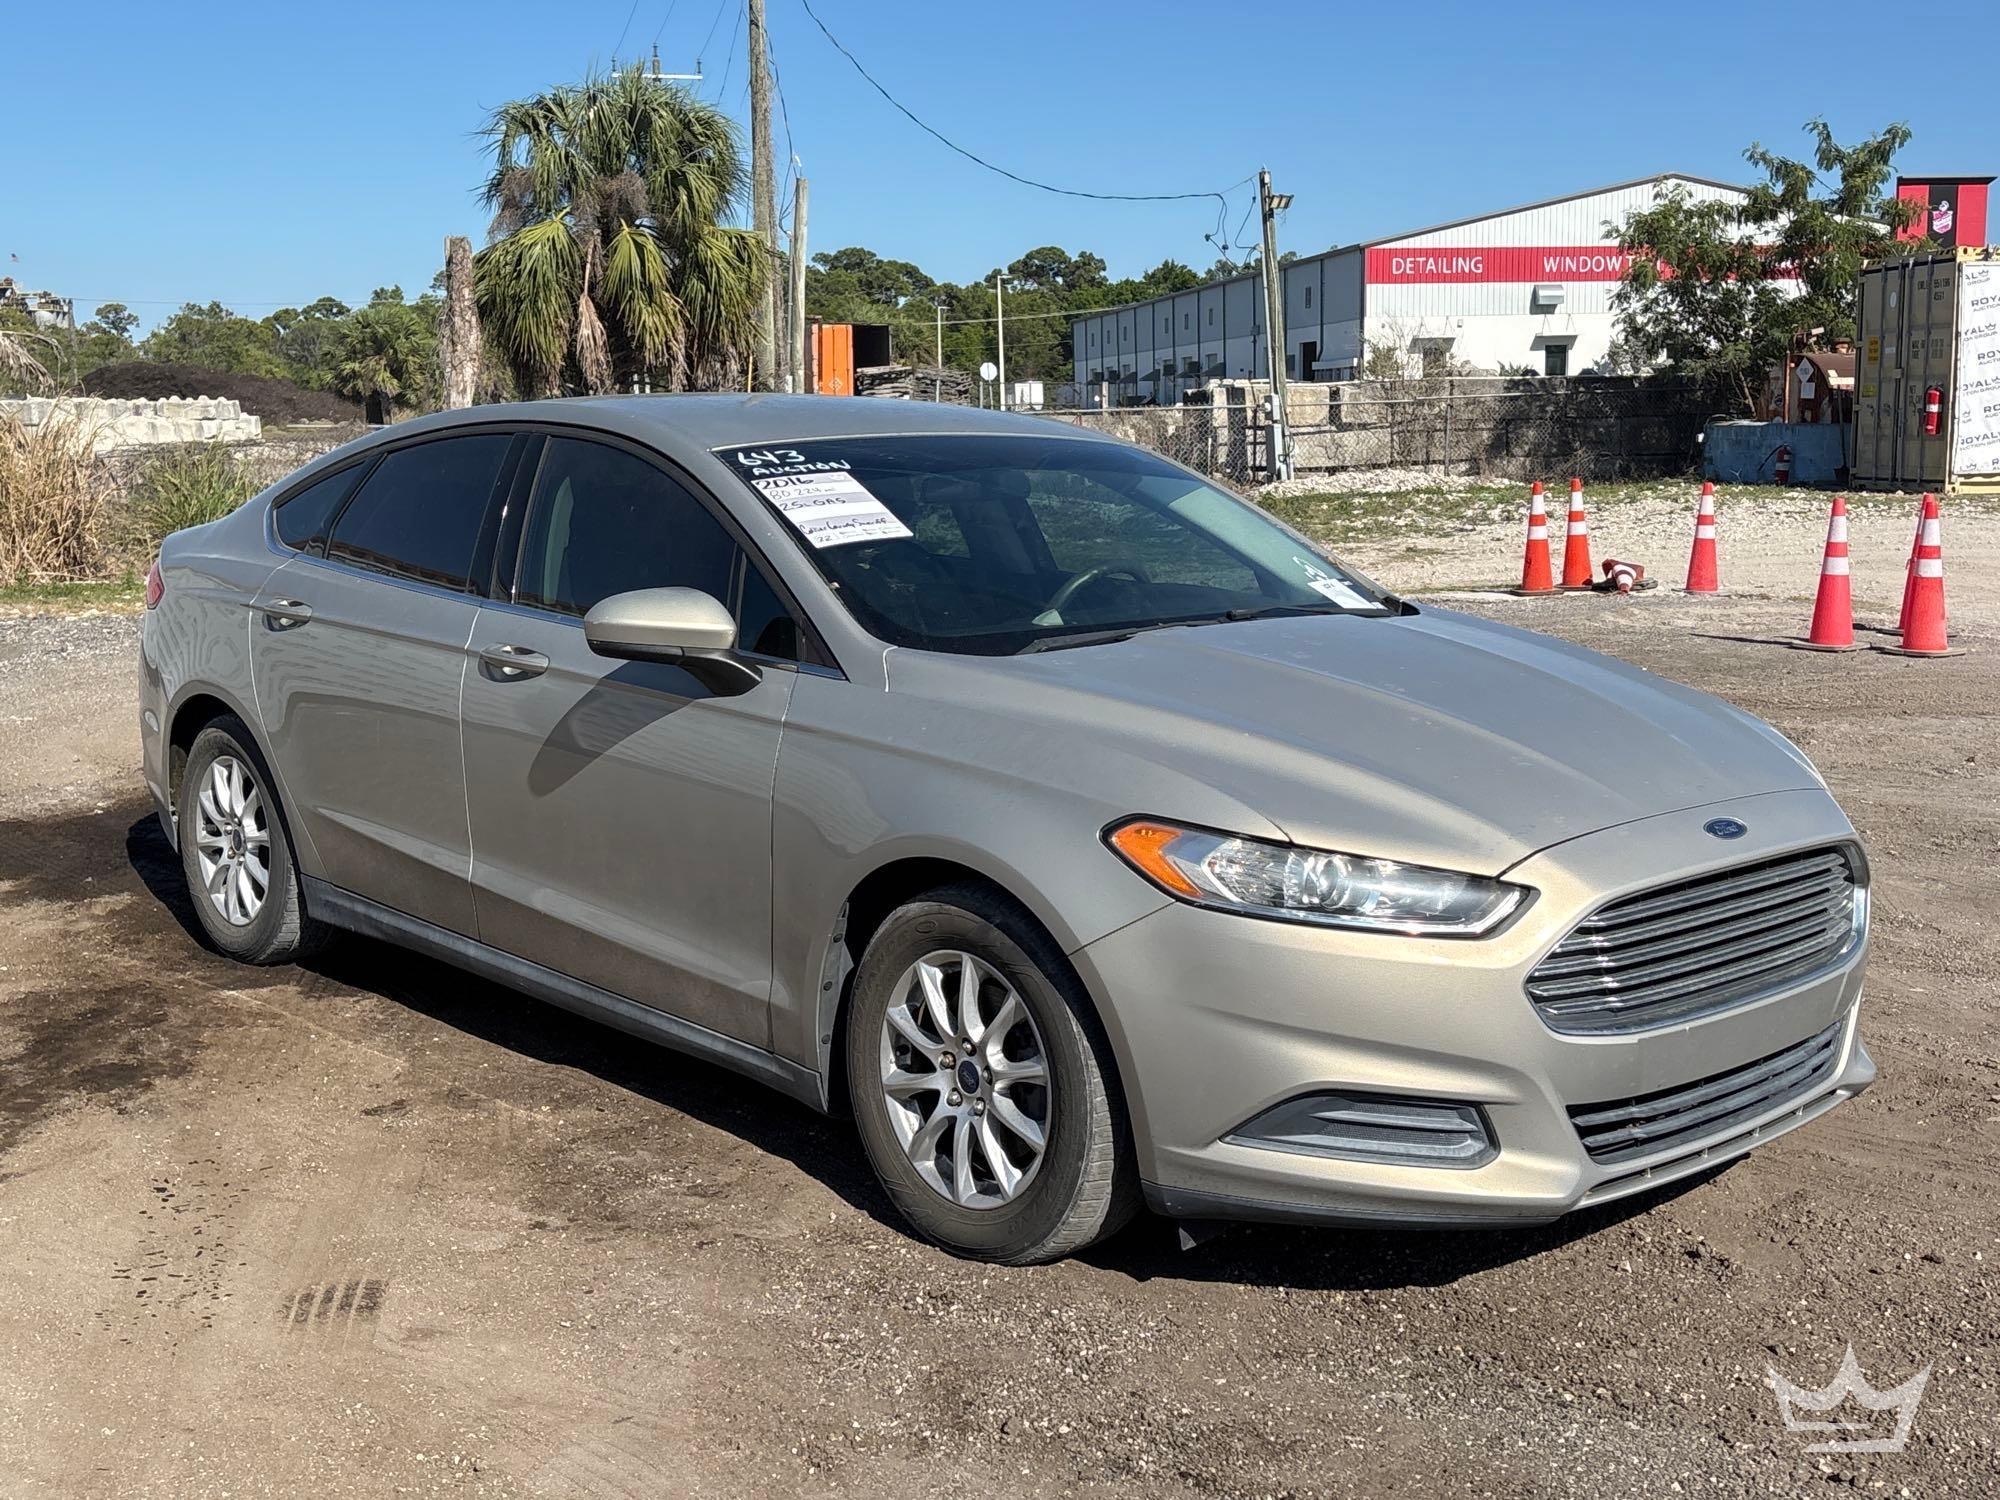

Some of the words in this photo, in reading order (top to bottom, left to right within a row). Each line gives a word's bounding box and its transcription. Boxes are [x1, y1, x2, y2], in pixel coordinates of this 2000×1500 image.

[1391, 256, 1484, 274] DETAILING
[1543, 255, 1623, 272] WINDOW
[737, 450, 806, 465] 643
[752, 459, 851, 476] AUCTION
[755, 476, 815, 490] 2016
